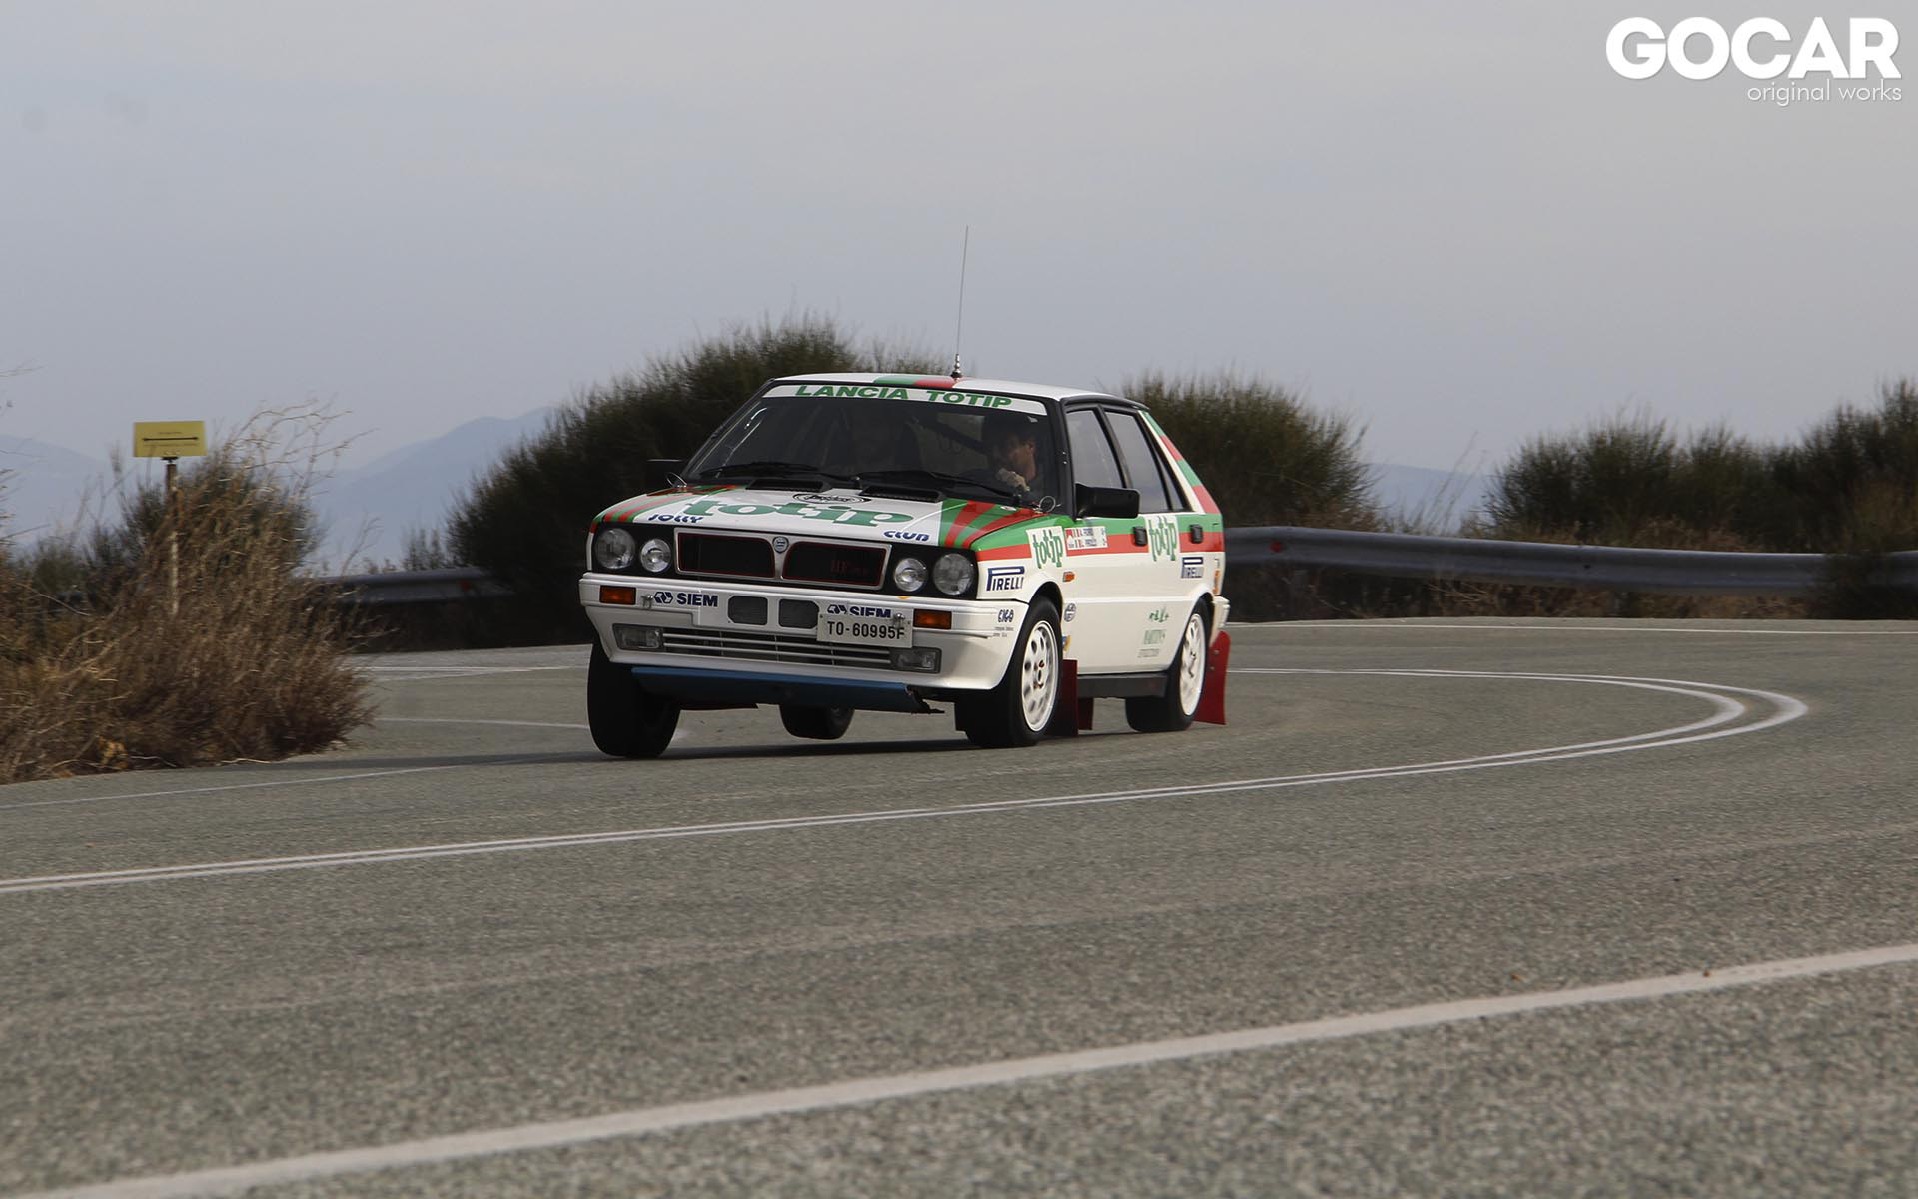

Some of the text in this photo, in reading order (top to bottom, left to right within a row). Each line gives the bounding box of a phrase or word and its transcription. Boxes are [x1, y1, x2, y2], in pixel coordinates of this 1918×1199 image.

[795, 385, 1012, 409] LANCIA TOTIP
[648, 513, 704, 524] JOLLY
[683, 500, 915, 528] totip
[883, 530, 930, 542] CLUB
[1148, 516, 1177, 561] totip
[1033, 529, 1063, 570] totip
[986, 566, 1025, 592] PIRELLI
[677, 592, 718, 607] SIEM
[827, 621, 905, 641] TO-60995F
